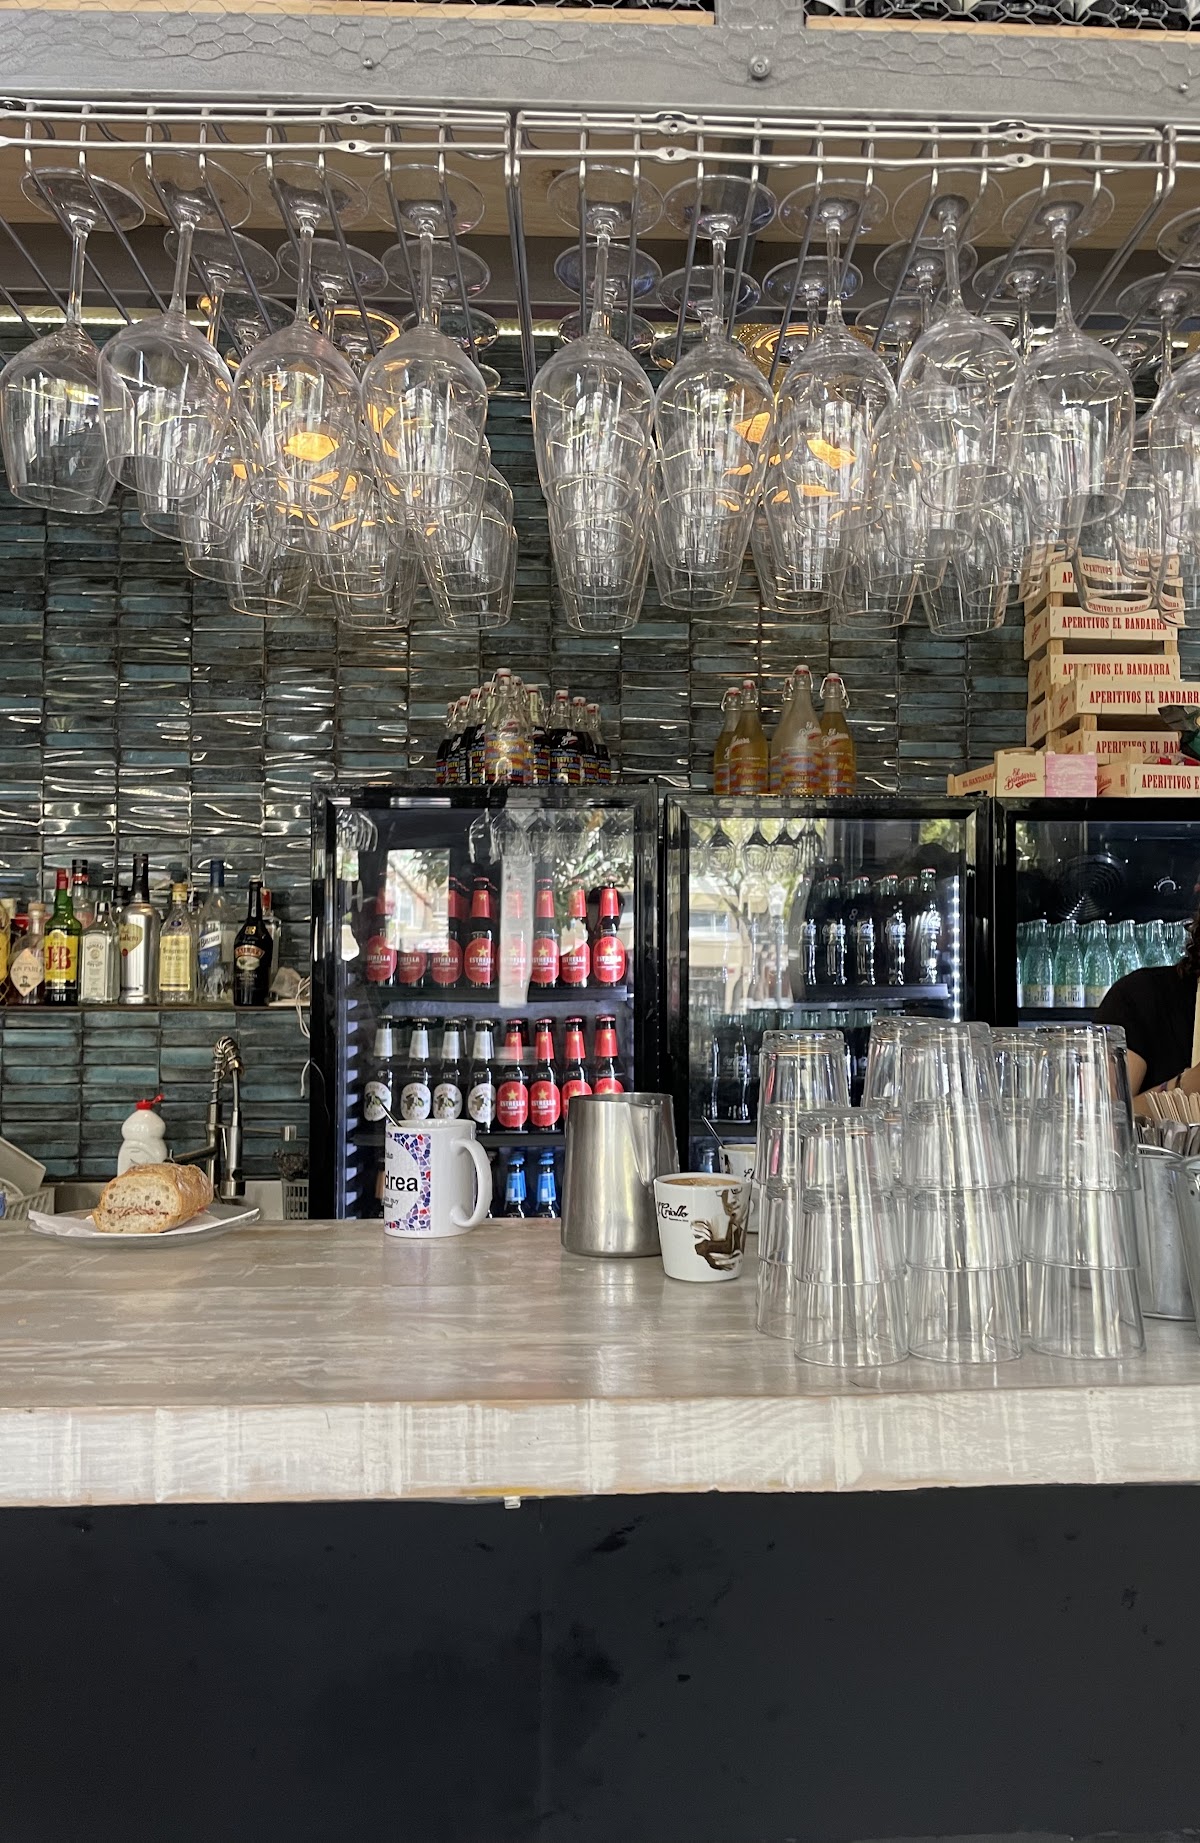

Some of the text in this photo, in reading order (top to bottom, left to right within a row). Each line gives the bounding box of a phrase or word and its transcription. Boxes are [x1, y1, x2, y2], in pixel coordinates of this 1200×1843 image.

[1062, 616, 1110, 629] APERITIVOS
[1112, 617, 1122, 629] EL
[1062, 663, 1170, 675] APTIVOS EL BANDARRA
[1089, 690, 1200, 703] APERITIVOS EL BANDARR
[1150, 741, 1160, 753] EL
[1141, 774, 1200, 789] APERITIVOS E
[500, 1099, 526, 1107] ESTRELLA
